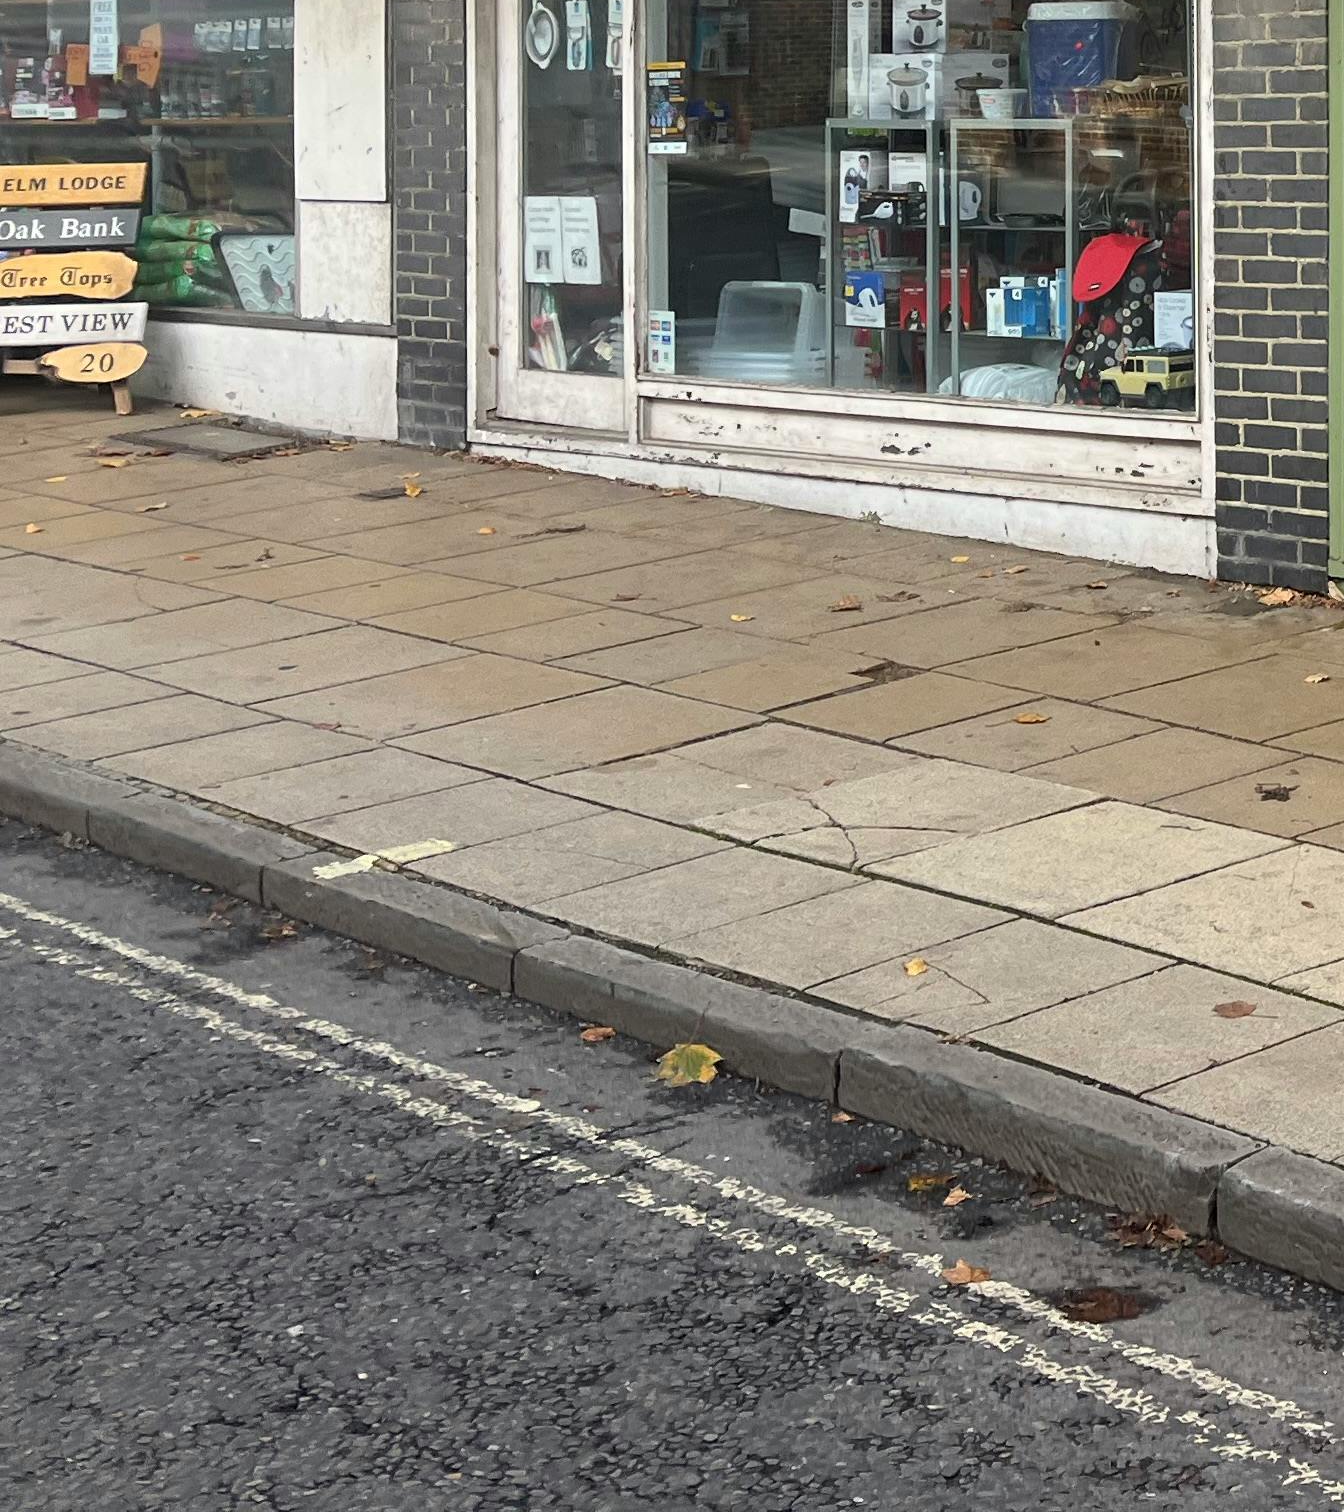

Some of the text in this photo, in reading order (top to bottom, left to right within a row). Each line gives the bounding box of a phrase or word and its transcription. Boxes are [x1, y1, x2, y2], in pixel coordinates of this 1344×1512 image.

[3, 175, 127, 192] ELM LODGE
[0, 216, 126, 240] Oak Bank
[0, 266, 113, 288] Tree Tops
[2, 312, 134, 334] EST VIEW
[79, 352, 115, 373] 20
